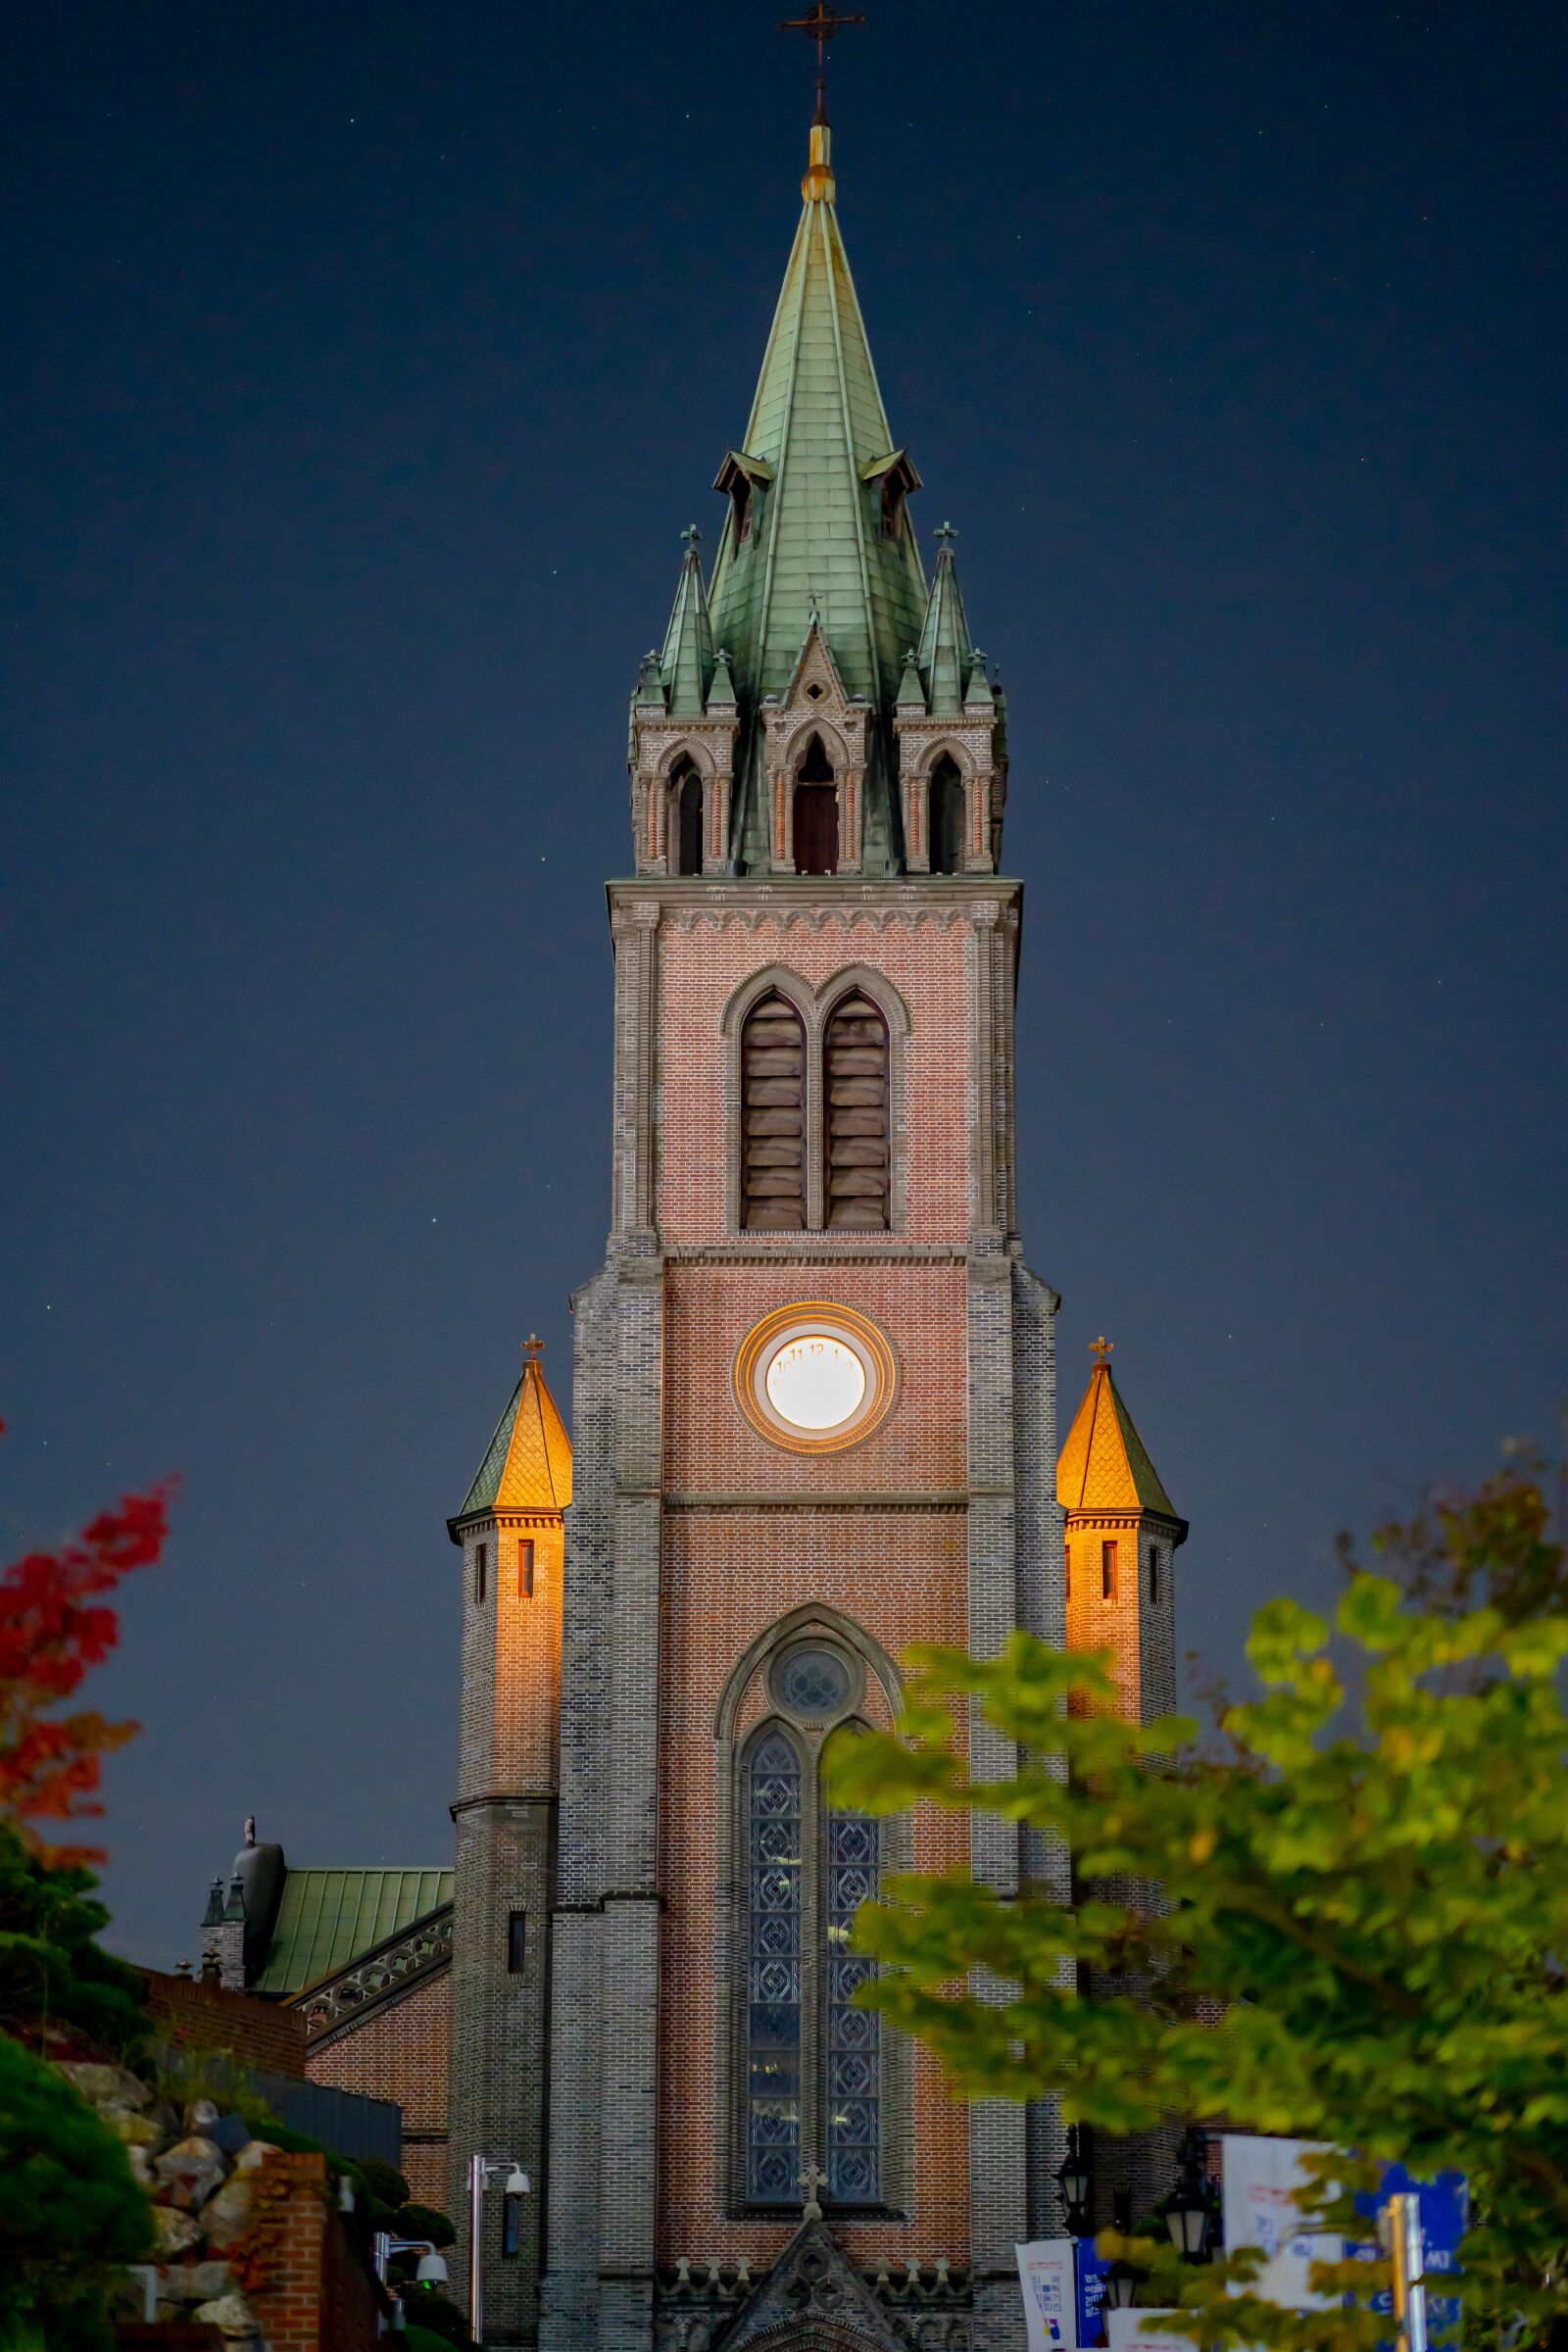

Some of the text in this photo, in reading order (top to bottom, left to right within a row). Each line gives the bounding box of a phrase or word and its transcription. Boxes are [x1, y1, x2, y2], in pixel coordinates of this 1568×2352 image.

[790, 1348, 803, 1361] 11
[808, 1344, 824, 1357] 12
[834, 1348, 839, 1360] 1
